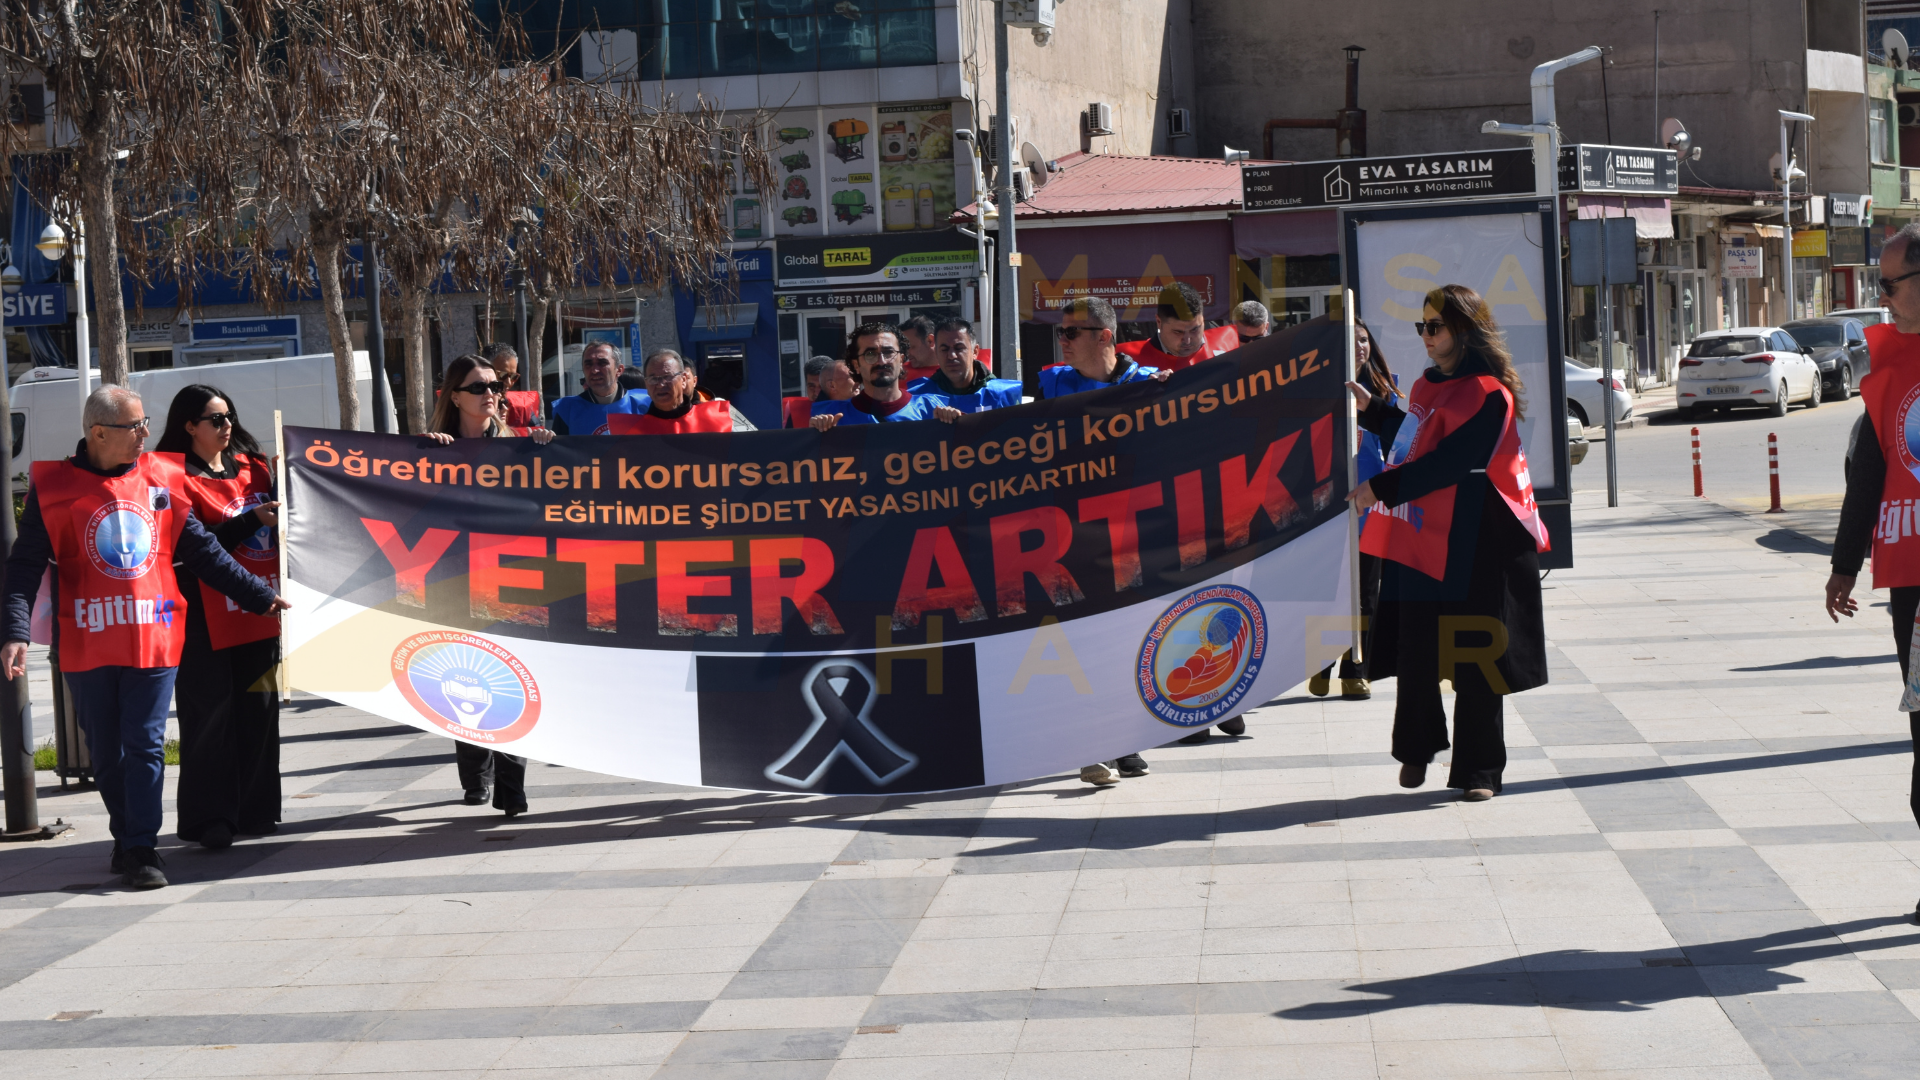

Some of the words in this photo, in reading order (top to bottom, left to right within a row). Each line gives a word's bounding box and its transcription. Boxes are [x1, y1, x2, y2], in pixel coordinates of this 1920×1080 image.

[1359, 164, 1396, 180] EVA
[1405, 158, 1493, 178] TASARIM
[1616, 154, 1628, 168] EVA
[1628, 156, 1655, 170] TASARIM
[1360, 181, 1408, 196] Mimarlık
[1426, 180, 1494, 192] Mühendislik
[1832, 198, 1846, 214] ÖZER
[784, 254, 818, 266] Global
[826, 252, 868, 262] TARAL
[939, 288, 952, 302] ES
[1092, 286, 1136, 294] MAHALLESİ
[785, 296, 798, 308] ES
[807, 296, 825, 305] E.S.
[827, 294, 852, 304] ÖZER
[854, 294, 886, 304] TARIM
[890, 294, 906, 302] ltd.
[908, 292, 923, 302] şti.
[1112, 297, 1130, 307] HOŞ
[1132, 294, 1159, 306] GELDİ
[221, 324, 268, 334] Bankamatik
[305, 439, 600, 489] Öğretmenleri
[618, 456, 868, 490] korursanız,
[884, 420, 1068, 486] geleceği
[1083, 348, 1330, 444] korursunuz.
[545, 500, 691, 526] EĞİTİMDE
[700, 498, 811, 529] ŞİDDET
[819, 486, 959, 518] YASASINI
[968, 455, 1116, 509] ÇIKARTIN!
[360, 516, 846, 637] YETER
[889, 412, 1334, 631] ARTIK!
[1138, 666, 1158, 702] BİRLEŞİK
[1196, 586, 1243, 602] SENDİKALARI
[1241, 594, 1264, 659] KONFEDERASYONU
[393, 647, 410, 670] EĞİTİM
[406, 640, 418, 650] VE
[418, 632, 442, 644] BİLİM
[444, 632, 512, 660] İŞGÖRENLERİ
[509, 659, 538, 702] SENDİKASI
[454, 674, 478, 685] 2005
[1154, 700, 1208, 725] BİRLEŞİK
[1212, 664, 1258, 716] KAMU-İŞ
[1198, 690, 1220, 704] 2008
[446, 723, 495, 742] EĞİTİM-İŞ
